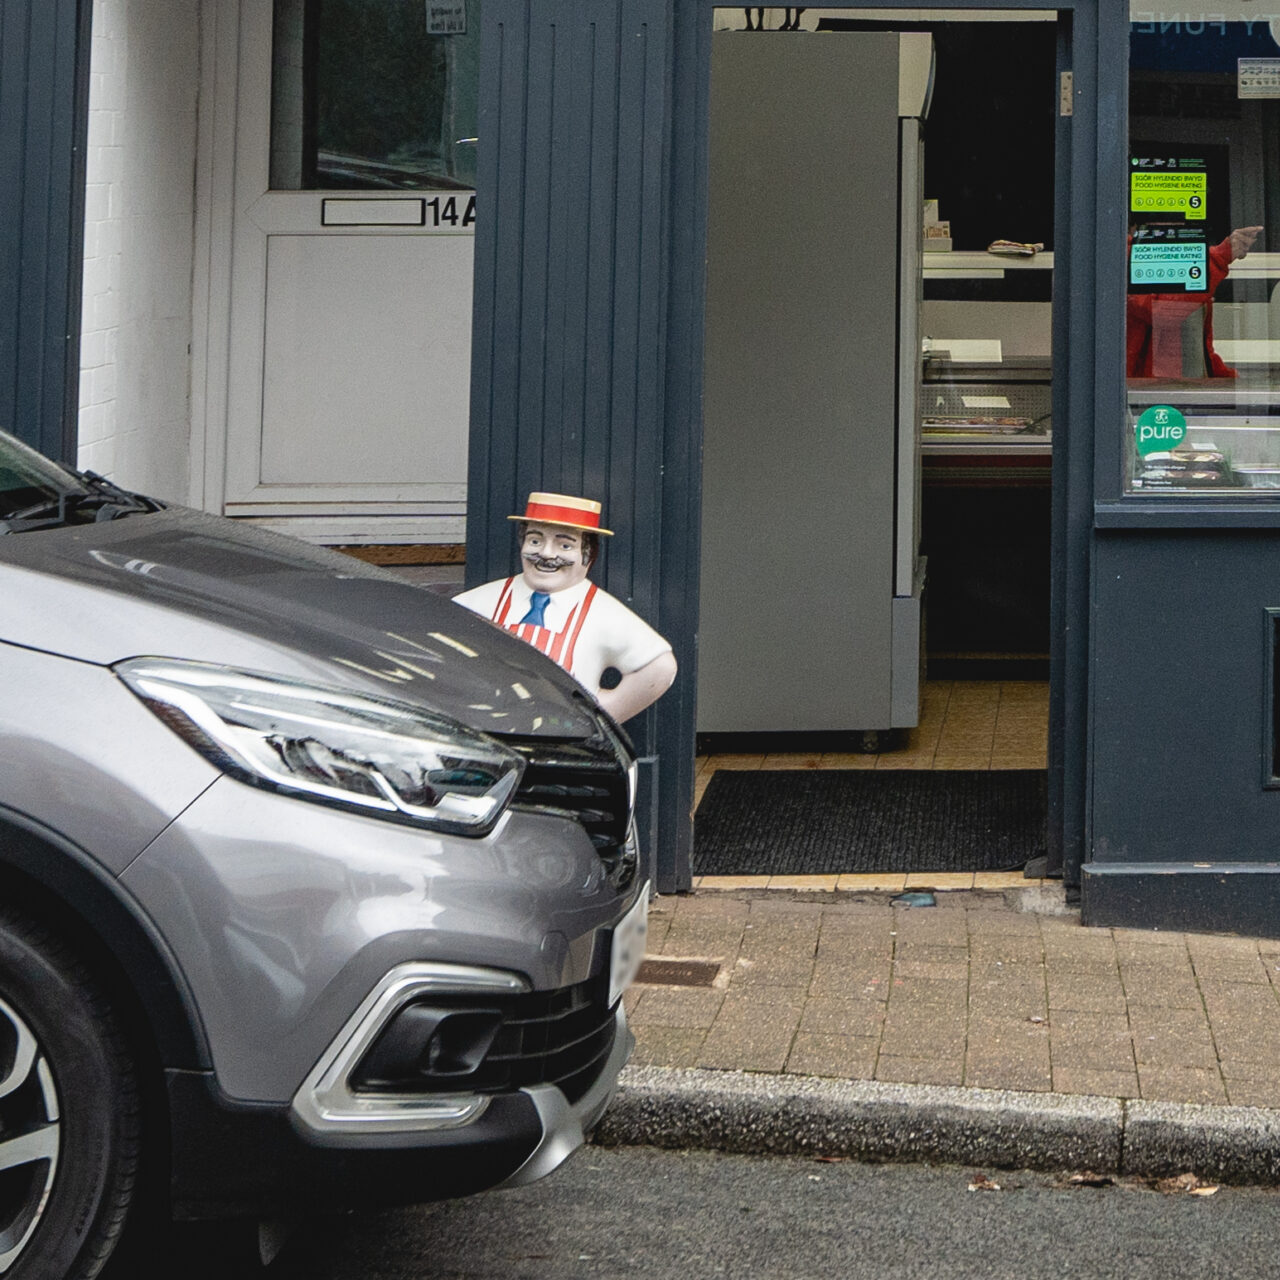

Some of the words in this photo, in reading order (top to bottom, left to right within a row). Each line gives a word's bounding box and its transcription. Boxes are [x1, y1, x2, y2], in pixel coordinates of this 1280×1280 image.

[1191, 197, 1200, 208] 5
[1191, 268, 1200, 278] 5
[1140, 425, 1183, 442] pure
